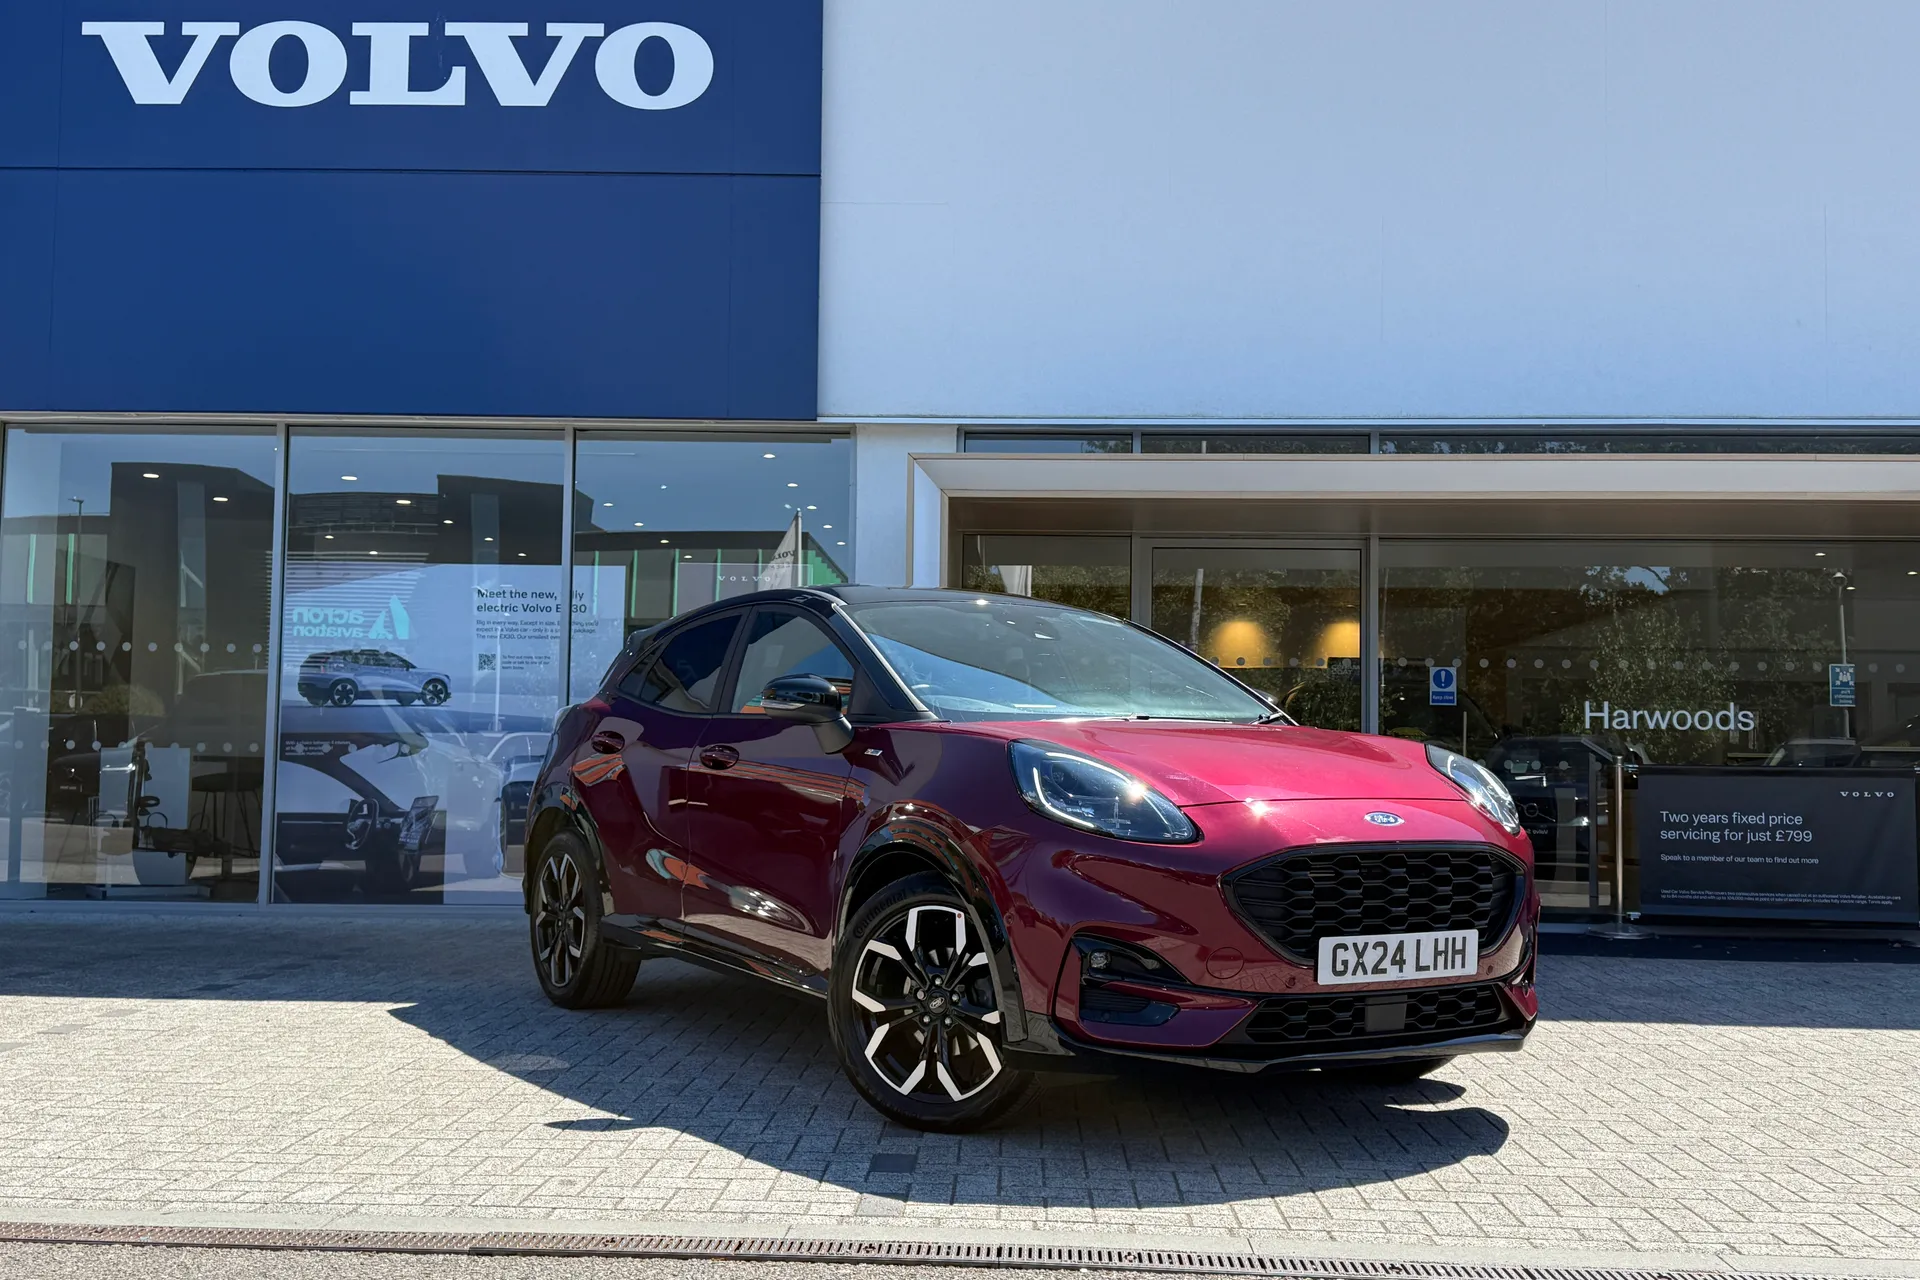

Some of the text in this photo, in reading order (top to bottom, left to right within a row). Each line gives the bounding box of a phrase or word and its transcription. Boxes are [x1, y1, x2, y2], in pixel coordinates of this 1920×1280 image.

[81, 20, 714, 110] VOLVO
[477, 589, 506, 599] Meet
[510, 589, 528, 599] the
[531, 591, 557, 600] new,
[477, 603, 587, 613] electric Volvo E30
[1584, 701, 1755, 730] Harwoods
[1660, 811, 1803, 827] Two years fixed price
[1660, 828, 1813, 844] servicing for just £799
[1660, 854, 1682, 862] Speak
[1331, 936, 1467, 977] GX24 LHH
